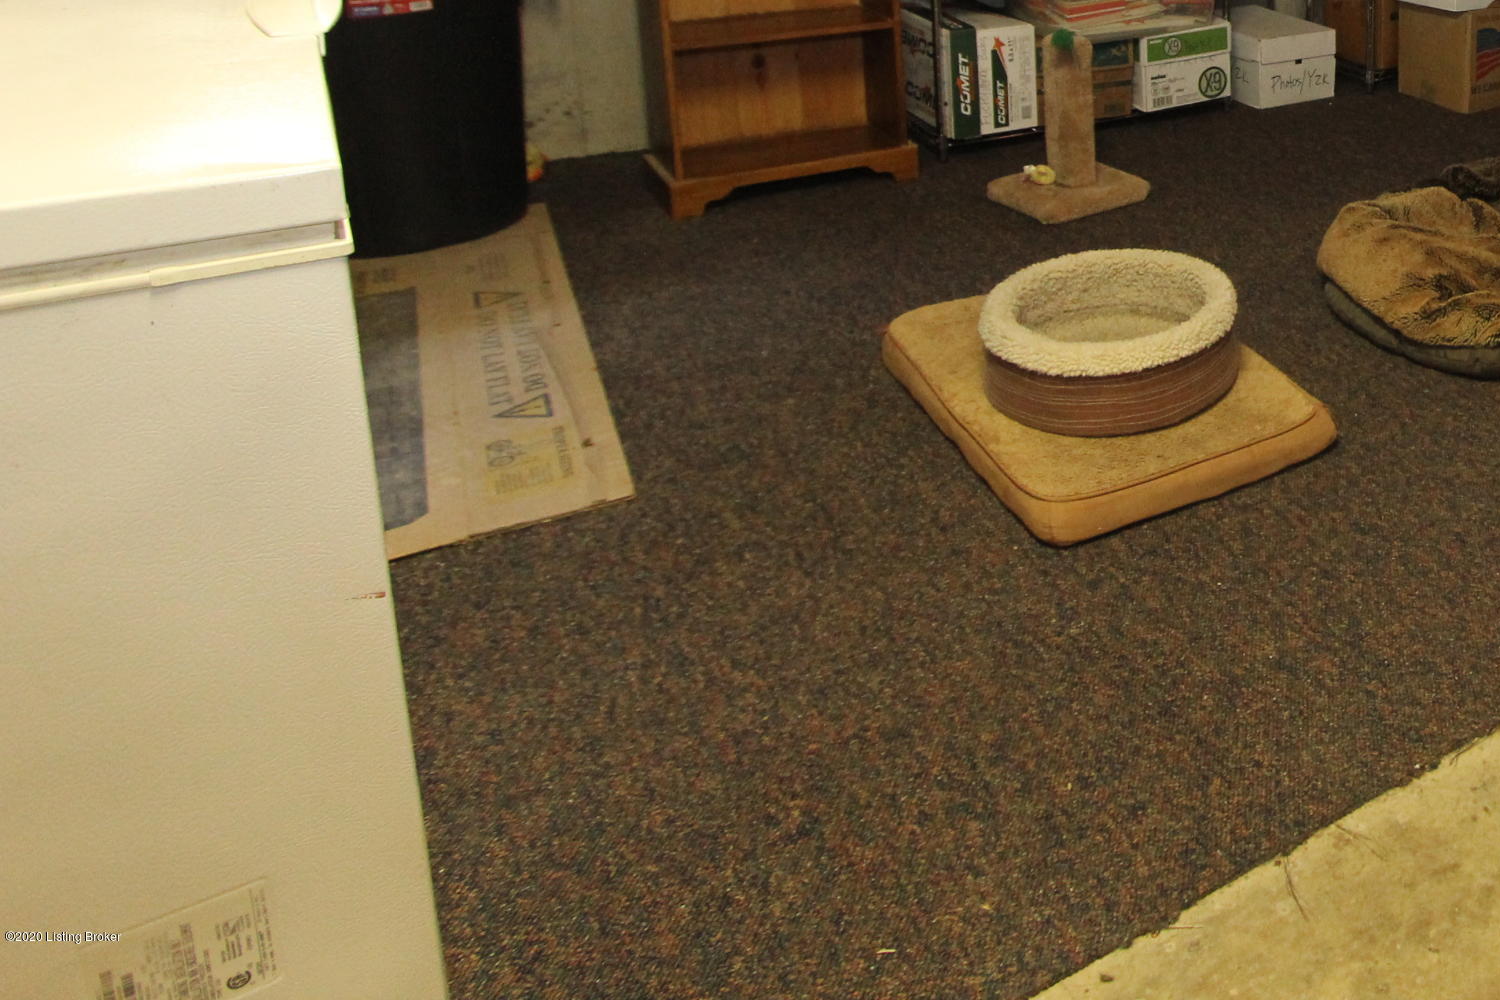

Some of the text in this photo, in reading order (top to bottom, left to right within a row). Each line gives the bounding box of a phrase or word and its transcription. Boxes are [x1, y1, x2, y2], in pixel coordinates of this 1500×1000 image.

[958, 53, 973, 116] COMET
[1271, 67, 1330, 92] Photos/Y2K
[997, 81, 1005, 125] COMET
